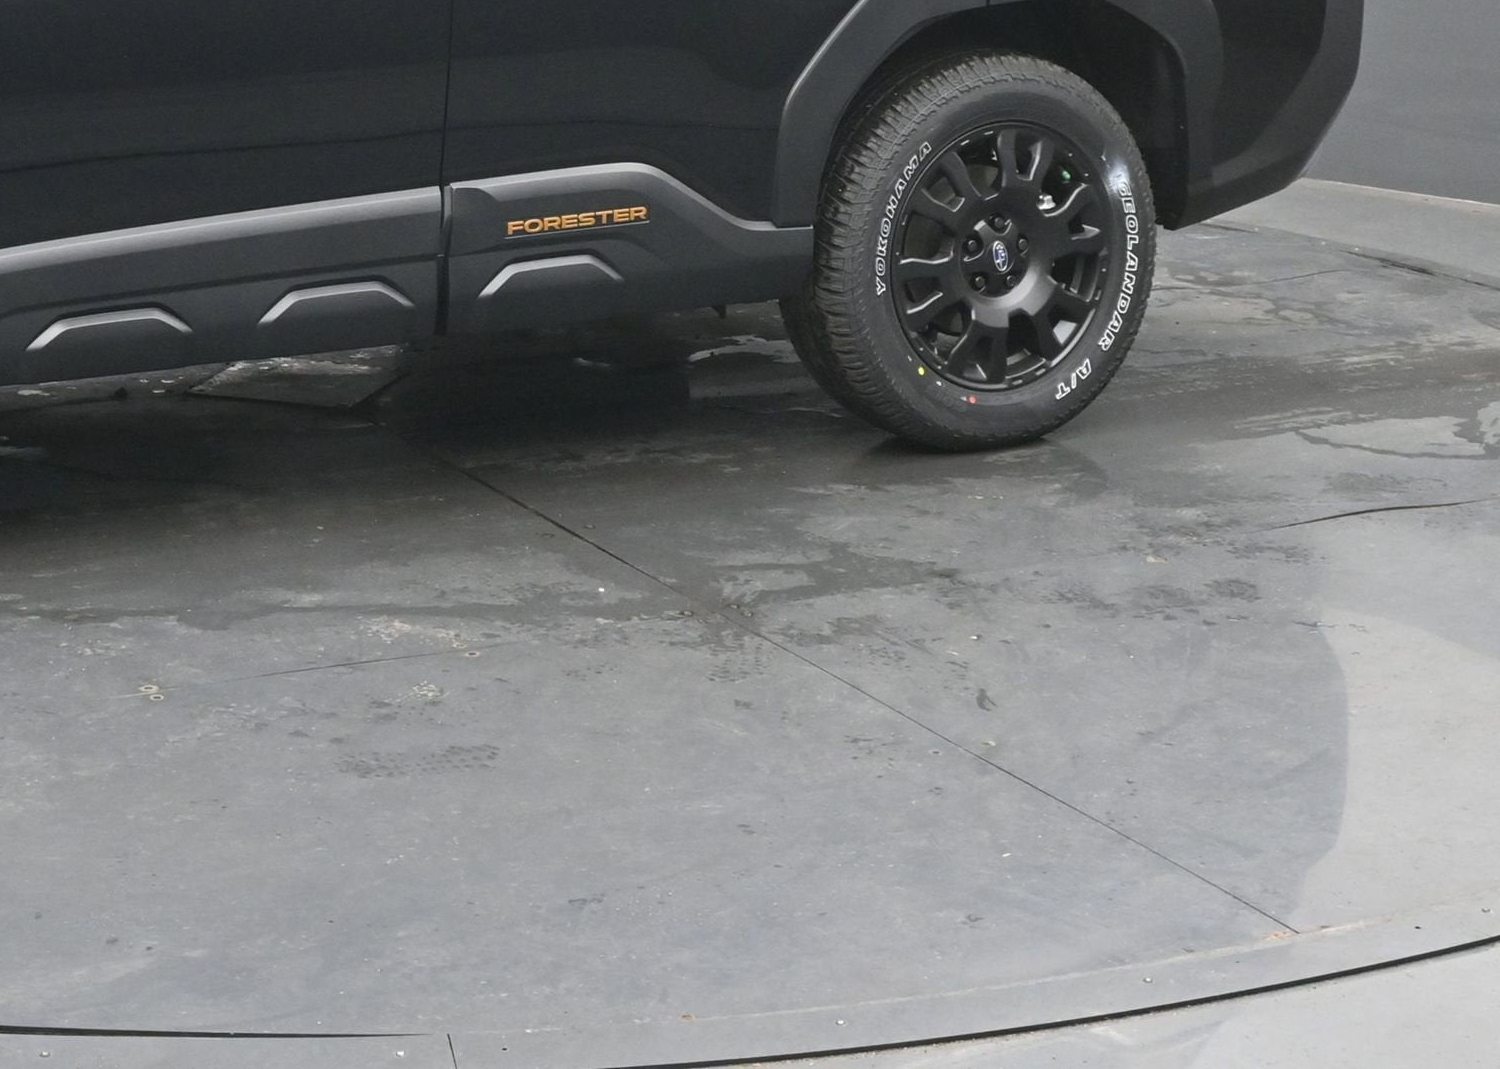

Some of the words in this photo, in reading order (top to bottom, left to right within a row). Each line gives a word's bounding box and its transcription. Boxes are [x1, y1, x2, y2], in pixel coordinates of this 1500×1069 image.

[507, 206, 649, 235] FORESTER
[875, 141, 932, 296] YOKOHAMA
[1098, 180, 1139, 351] GEOLANDAR
[1055, 357, 1092, 401] A/T
